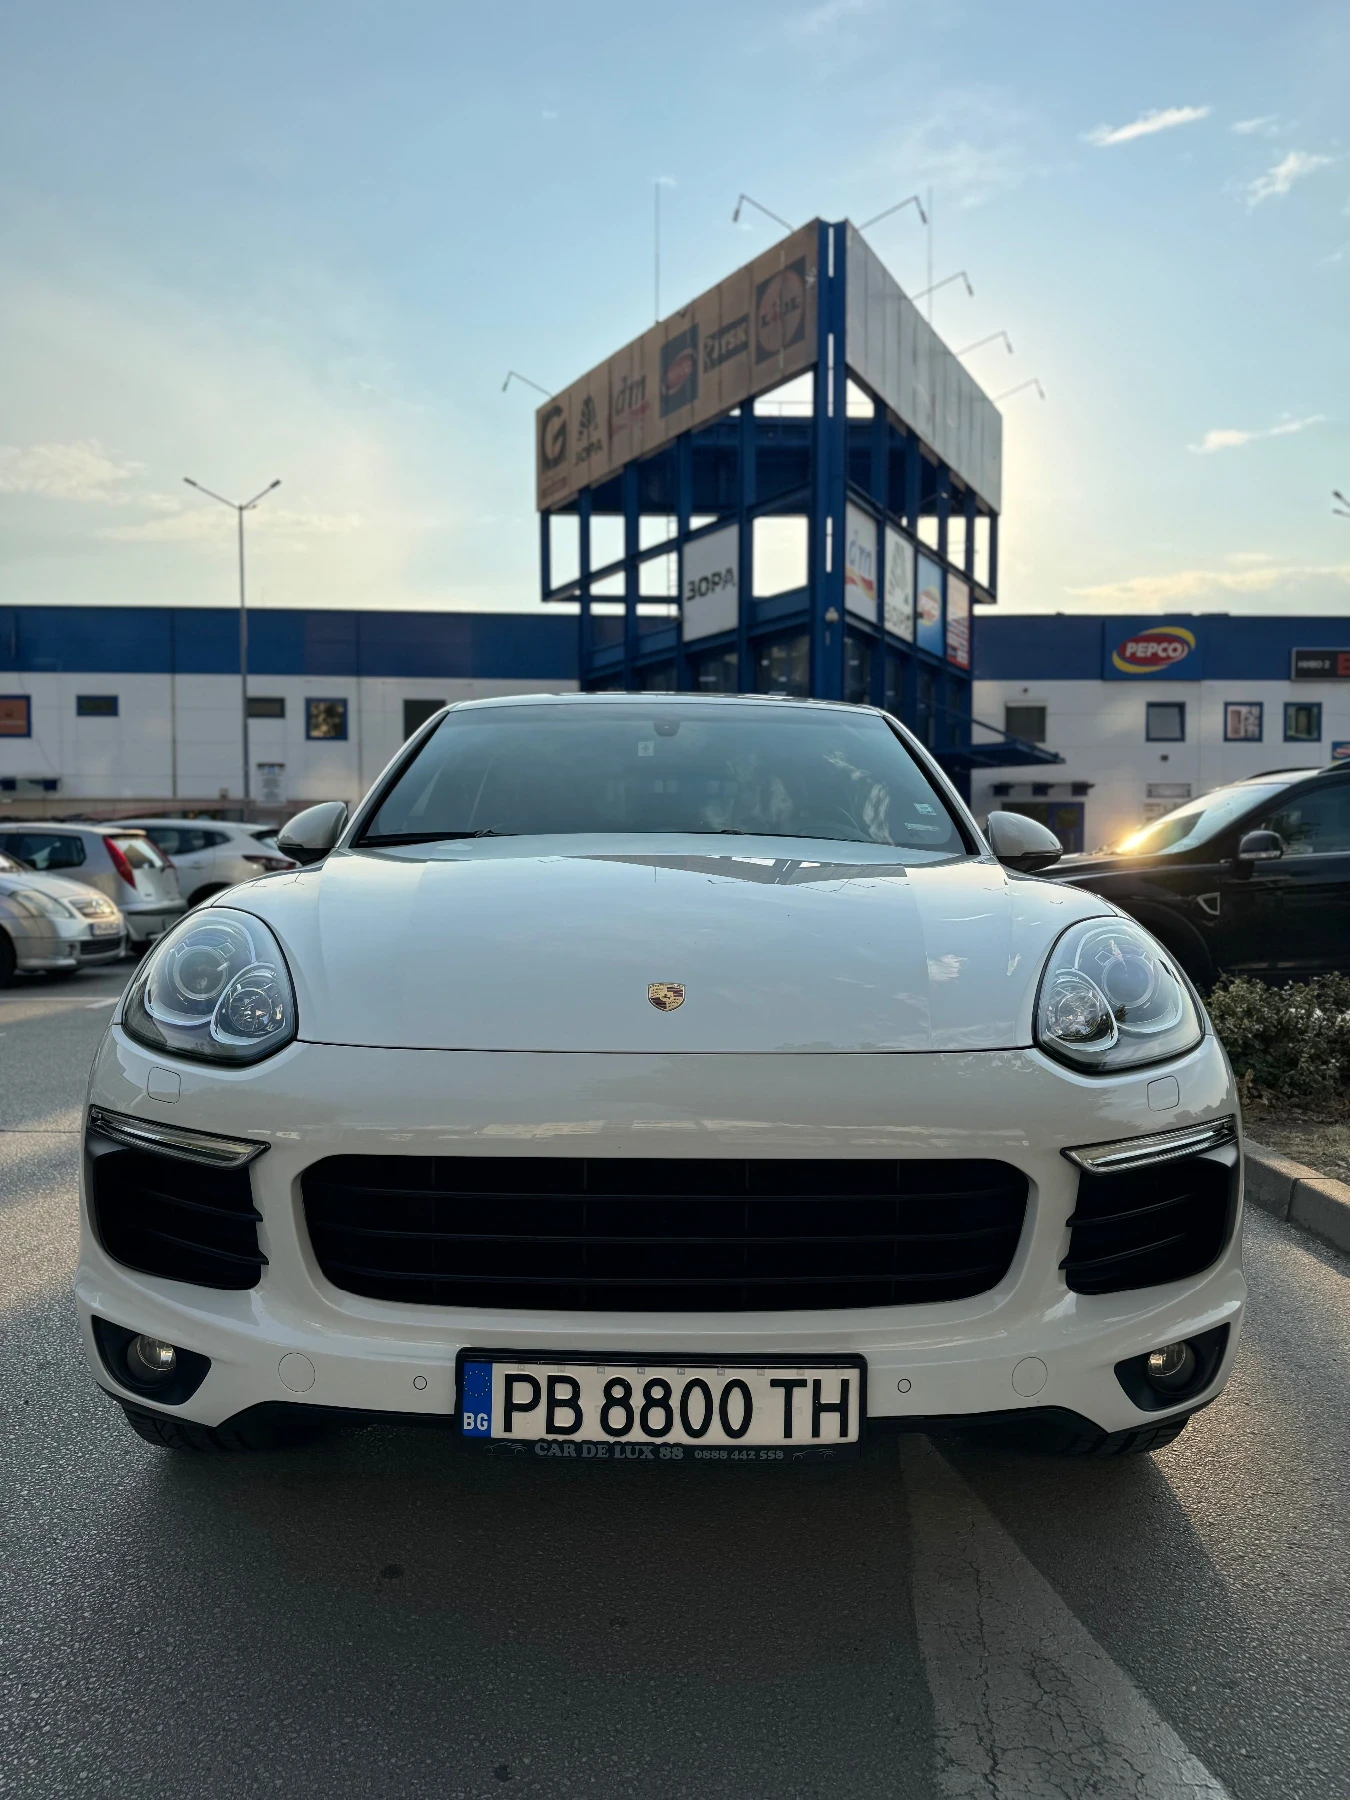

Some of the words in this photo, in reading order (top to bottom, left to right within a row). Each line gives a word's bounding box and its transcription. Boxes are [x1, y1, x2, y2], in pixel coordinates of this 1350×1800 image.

[686, 567, 737, 602] ЗОРА
[1125, 642, 1183, 658] PEPCO
[503, 1373, 583, 1435] PB
[600, 1376, 753, 1439] 8800
[770, 1379, 850, 1438] TH
[463, 1412, 489, 1431] BG
[534, 1442, 577, 1457] CAR
[581, 1444, 609, 1458] DE
[613, 1445, 655, 1459] LUX
[659, 1446, 684, 1459] 88
[694, 1450, 728, 1460] 0888
[730, 1450, 756, 1460] 442
[759, 1450, 784, 1460] 558
